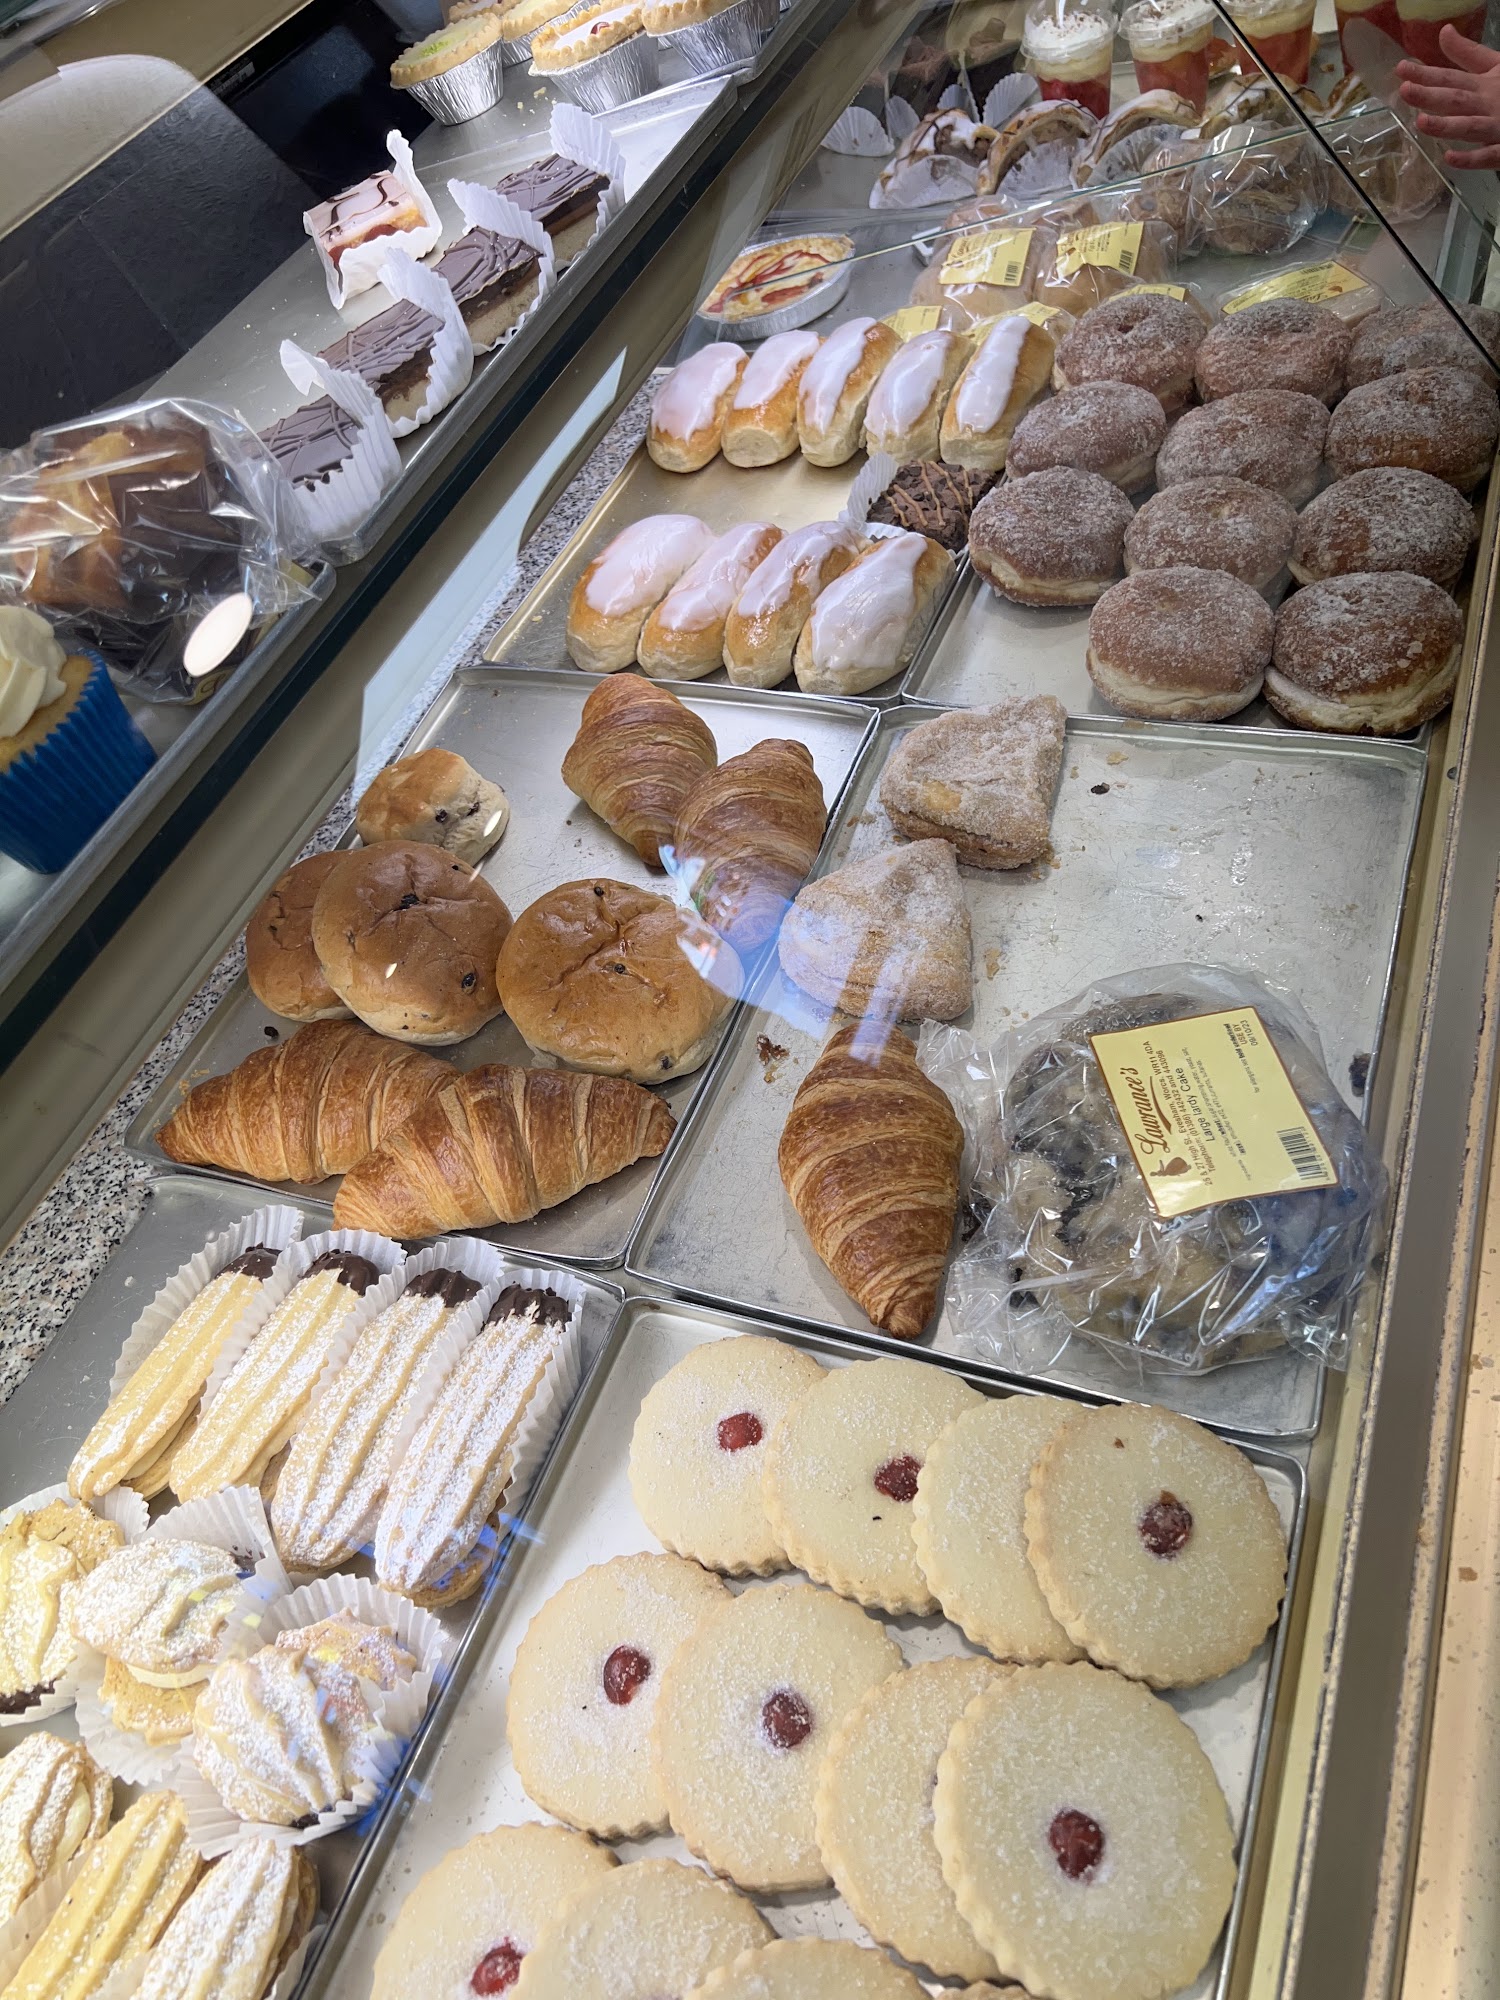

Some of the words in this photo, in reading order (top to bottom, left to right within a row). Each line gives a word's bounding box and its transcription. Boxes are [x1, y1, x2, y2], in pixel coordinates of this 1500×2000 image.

[1232, 1023, 1242, 1032] BY
[1142, 1040, 1153, 1054] 4DA
[1235, 1032, 1247, 1045] USE
[1148, 1056, 1162, 1075] WR11
[1165, 1074, 1177, 1088] and
[1175, 1067, 1191, 1092] Cake
[1171, 1089, 1186, 1112] 442432
[1186, 1094, 1202, 1115] lardy
[1119, 1067, 1170, 1154] Lawrance's
[1181, 1113, 1200, 1136] (01386)
[1197, 1117, 1215, 1141] Large
[1187, 1145, 1200, 1161] High
[1194, 1162, 1205, 1170] 27
